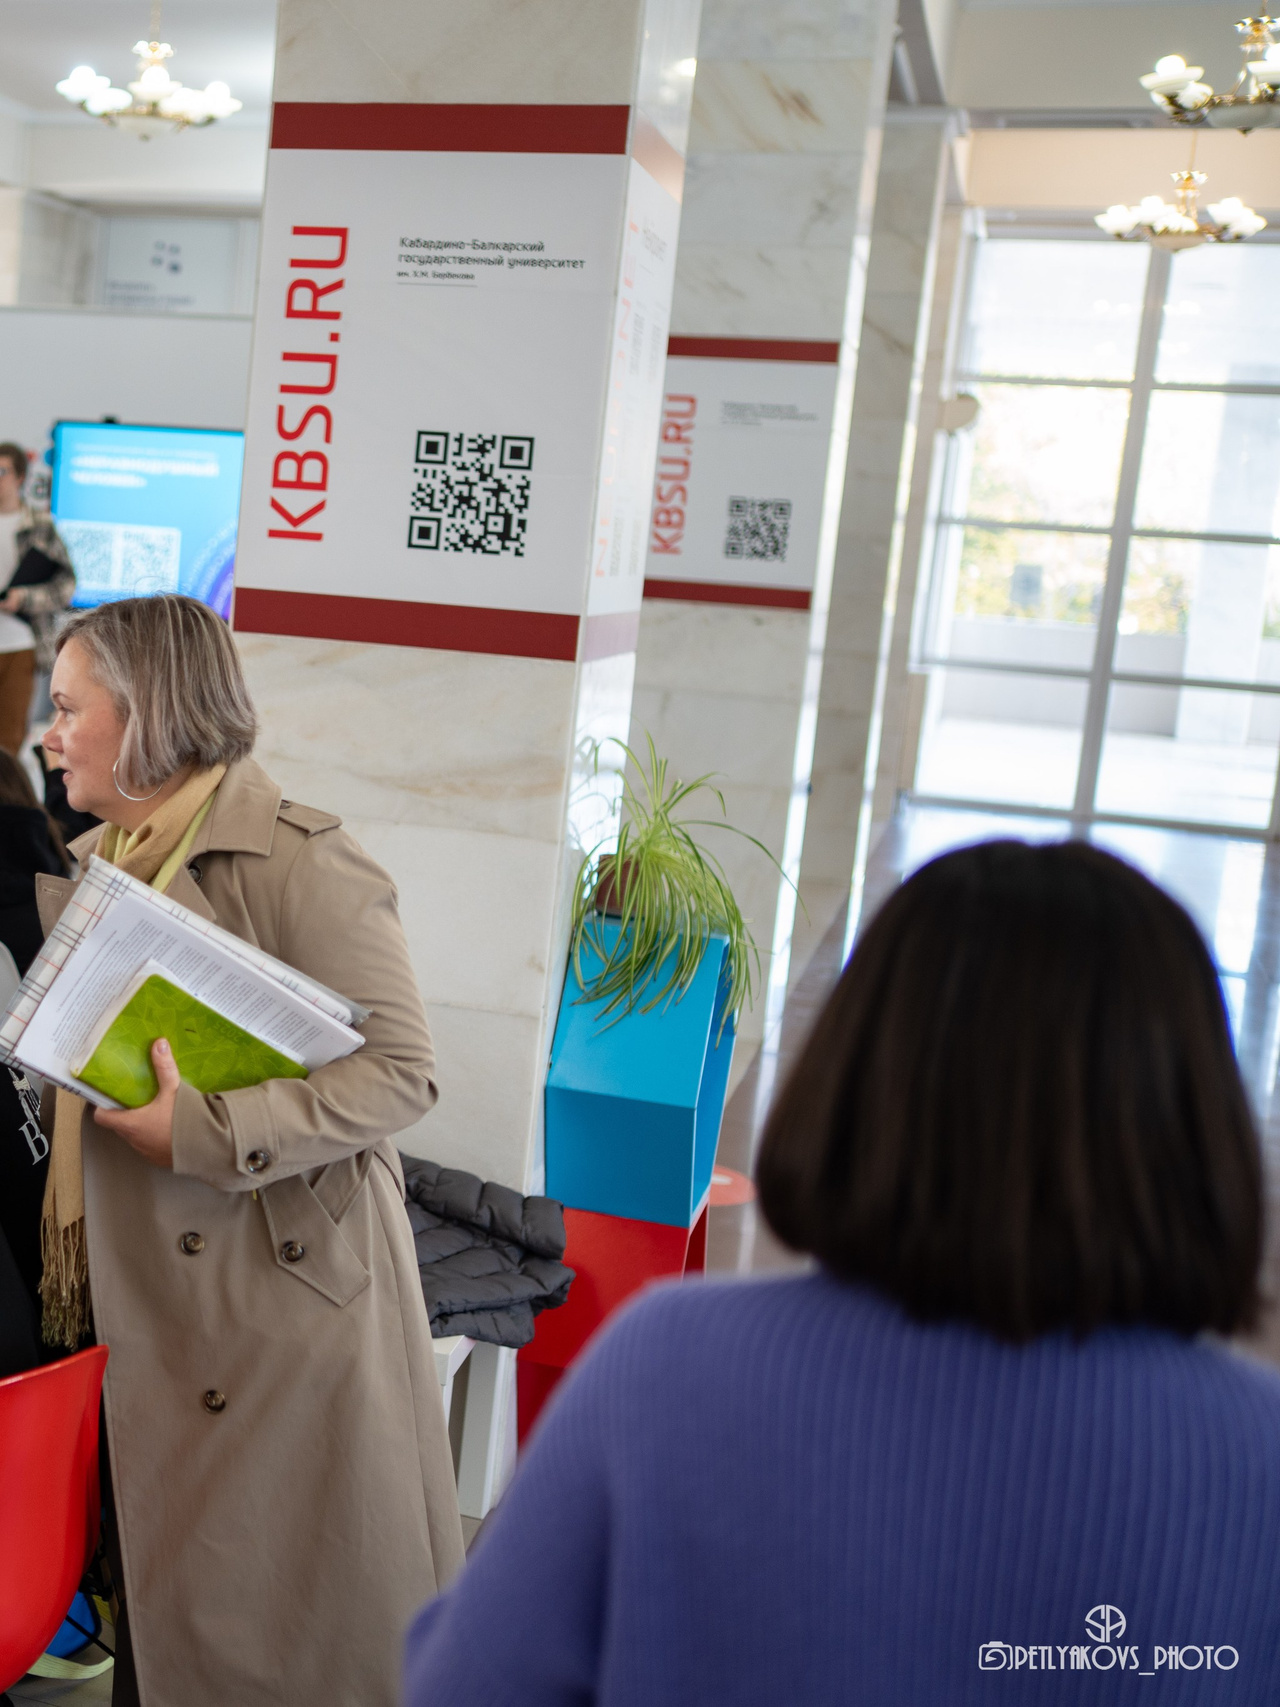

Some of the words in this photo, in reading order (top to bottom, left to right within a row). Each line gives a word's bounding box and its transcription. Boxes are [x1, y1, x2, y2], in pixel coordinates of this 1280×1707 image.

[398, 253, 504, 267] государственный
[508, 258, 586, 269] университет
[399, 237, 545, 252] Кабардино-Балкарский
[268, 226, 349, 542] KBSU.RU
[651, 394, 698, 555] KBSU.RU
